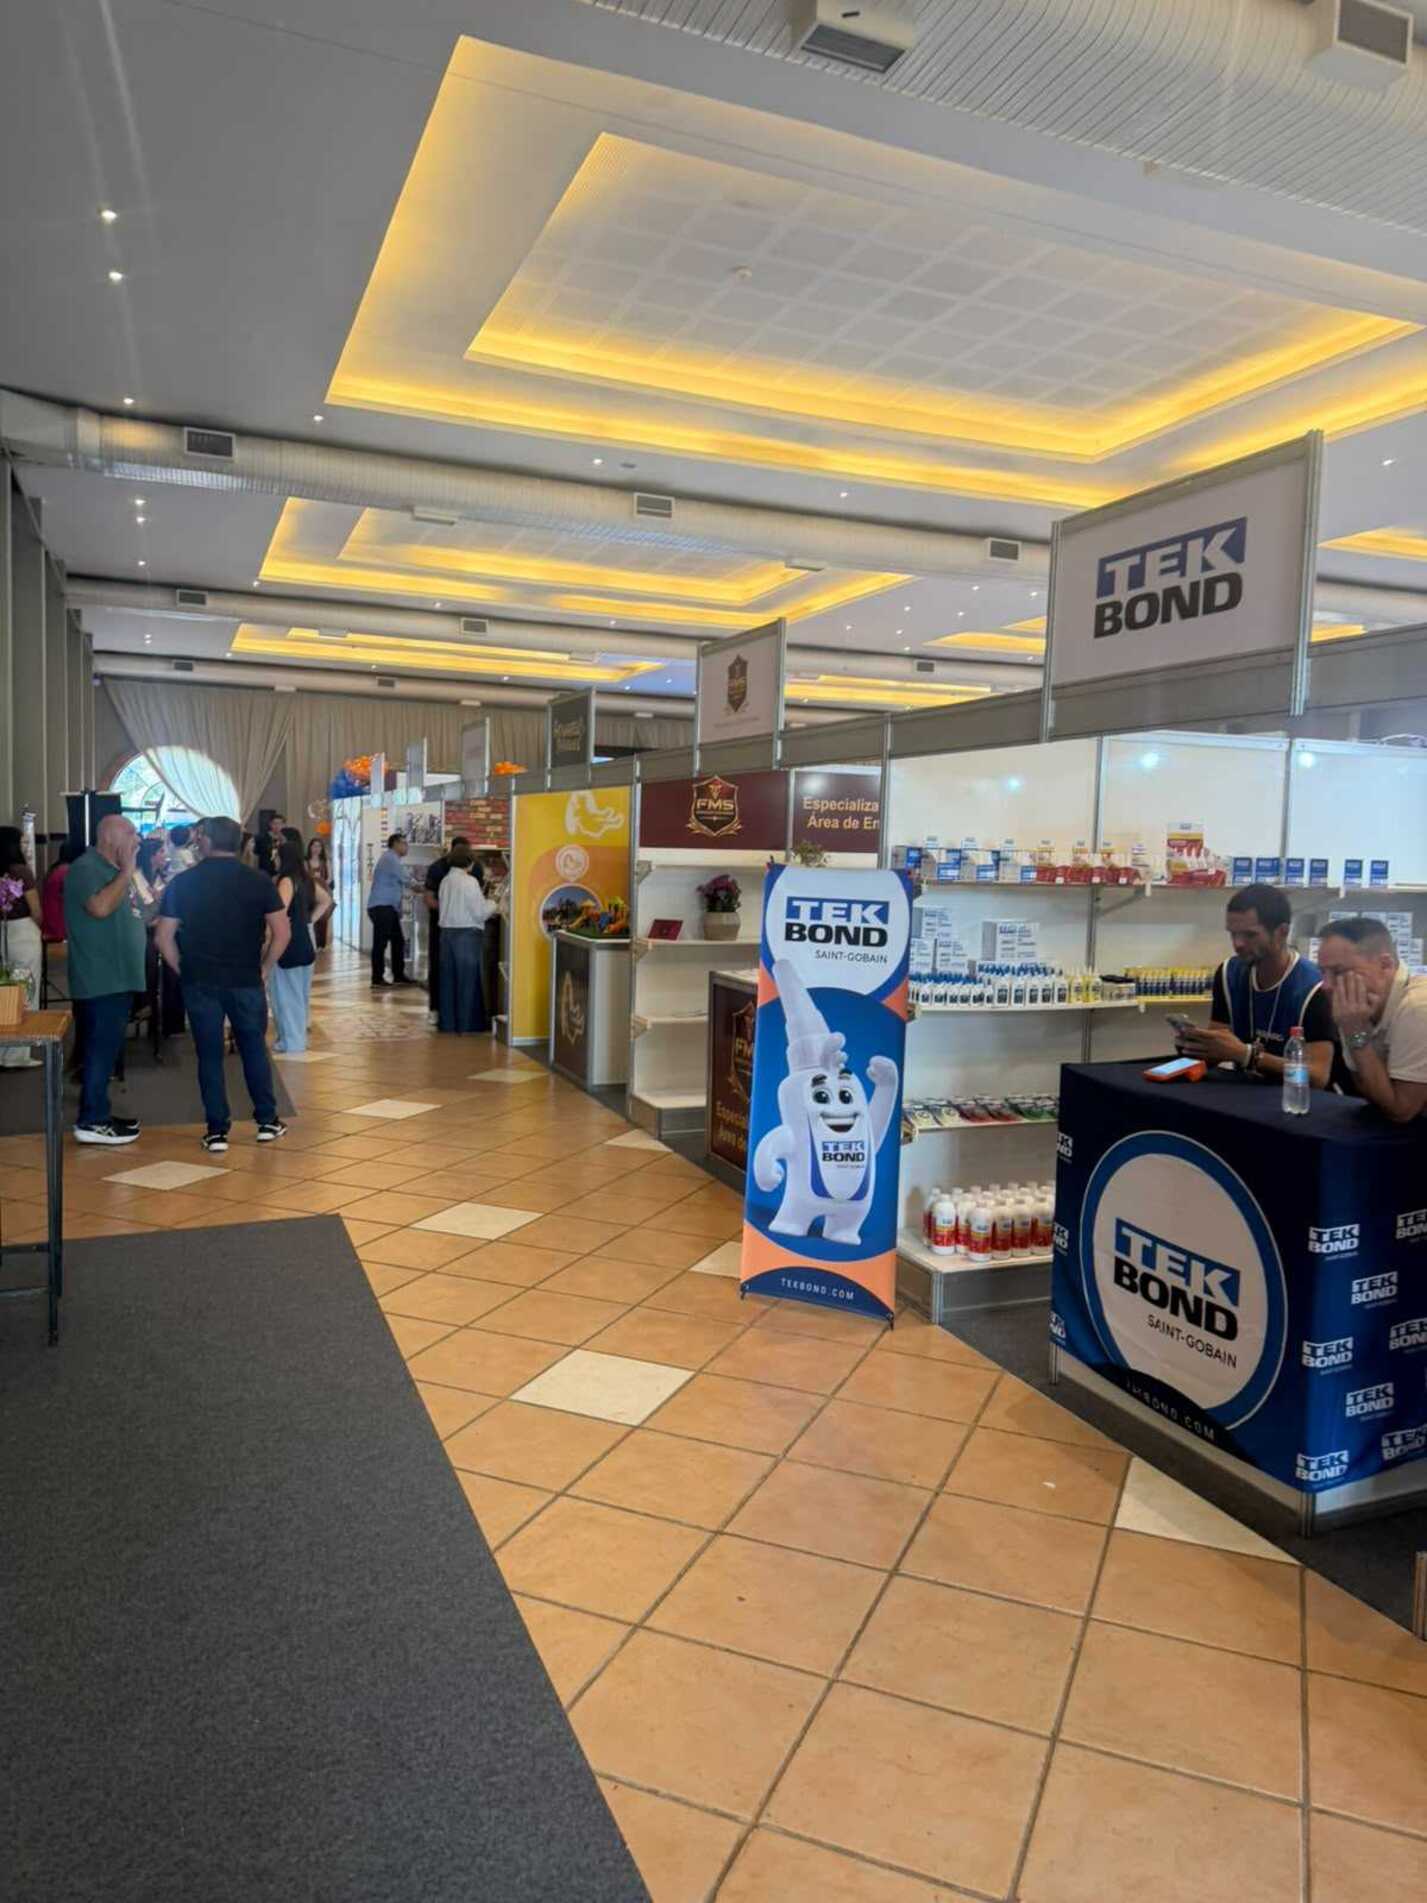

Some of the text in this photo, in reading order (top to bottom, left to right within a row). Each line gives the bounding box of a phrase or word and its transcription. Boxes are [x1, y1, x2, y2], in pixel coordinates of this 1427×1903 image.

[1097, 517, 1247, 599] TEK
[1094, 571, 1243, 639] BOND
[696, 799, 735, 811] FMS
[806, 811, 839, 829] Área
[843, 815, 859, 829] de
[786, 896, 890, 925] TEK
[784, 922, 889, 948] BOND
[815, 949, 888, 964] SAINT-GOBAIN
[822, 1141, 865, 1151] TEK
[822, 1152, 865, 1162] BOND
[1309, 1224, 1360, 1242] TEK
[1308, 1238, 1359, 1253] BOND
[1115, 1218, 1240, 1307] TEK
[1352, 1271, 1398, 1293] TEK
[1113, 1256, 1238, 1341] BOND
[1351, 1285, 1398, 1304] BOND
[1147, 1313, 1237, 1369] SAINT-GOBAIN
[1303, 1337, 1353, 1357] TEK
[1302, 1351, 1353, 1368] BOND
[1346, 1382, 1394, 1406] TEK
[1345, 1397, 1394, 1418] BOND
[1297, 1450, 1349, 1470] TEK
[1296, 1465, 1348, 1482] BOND
